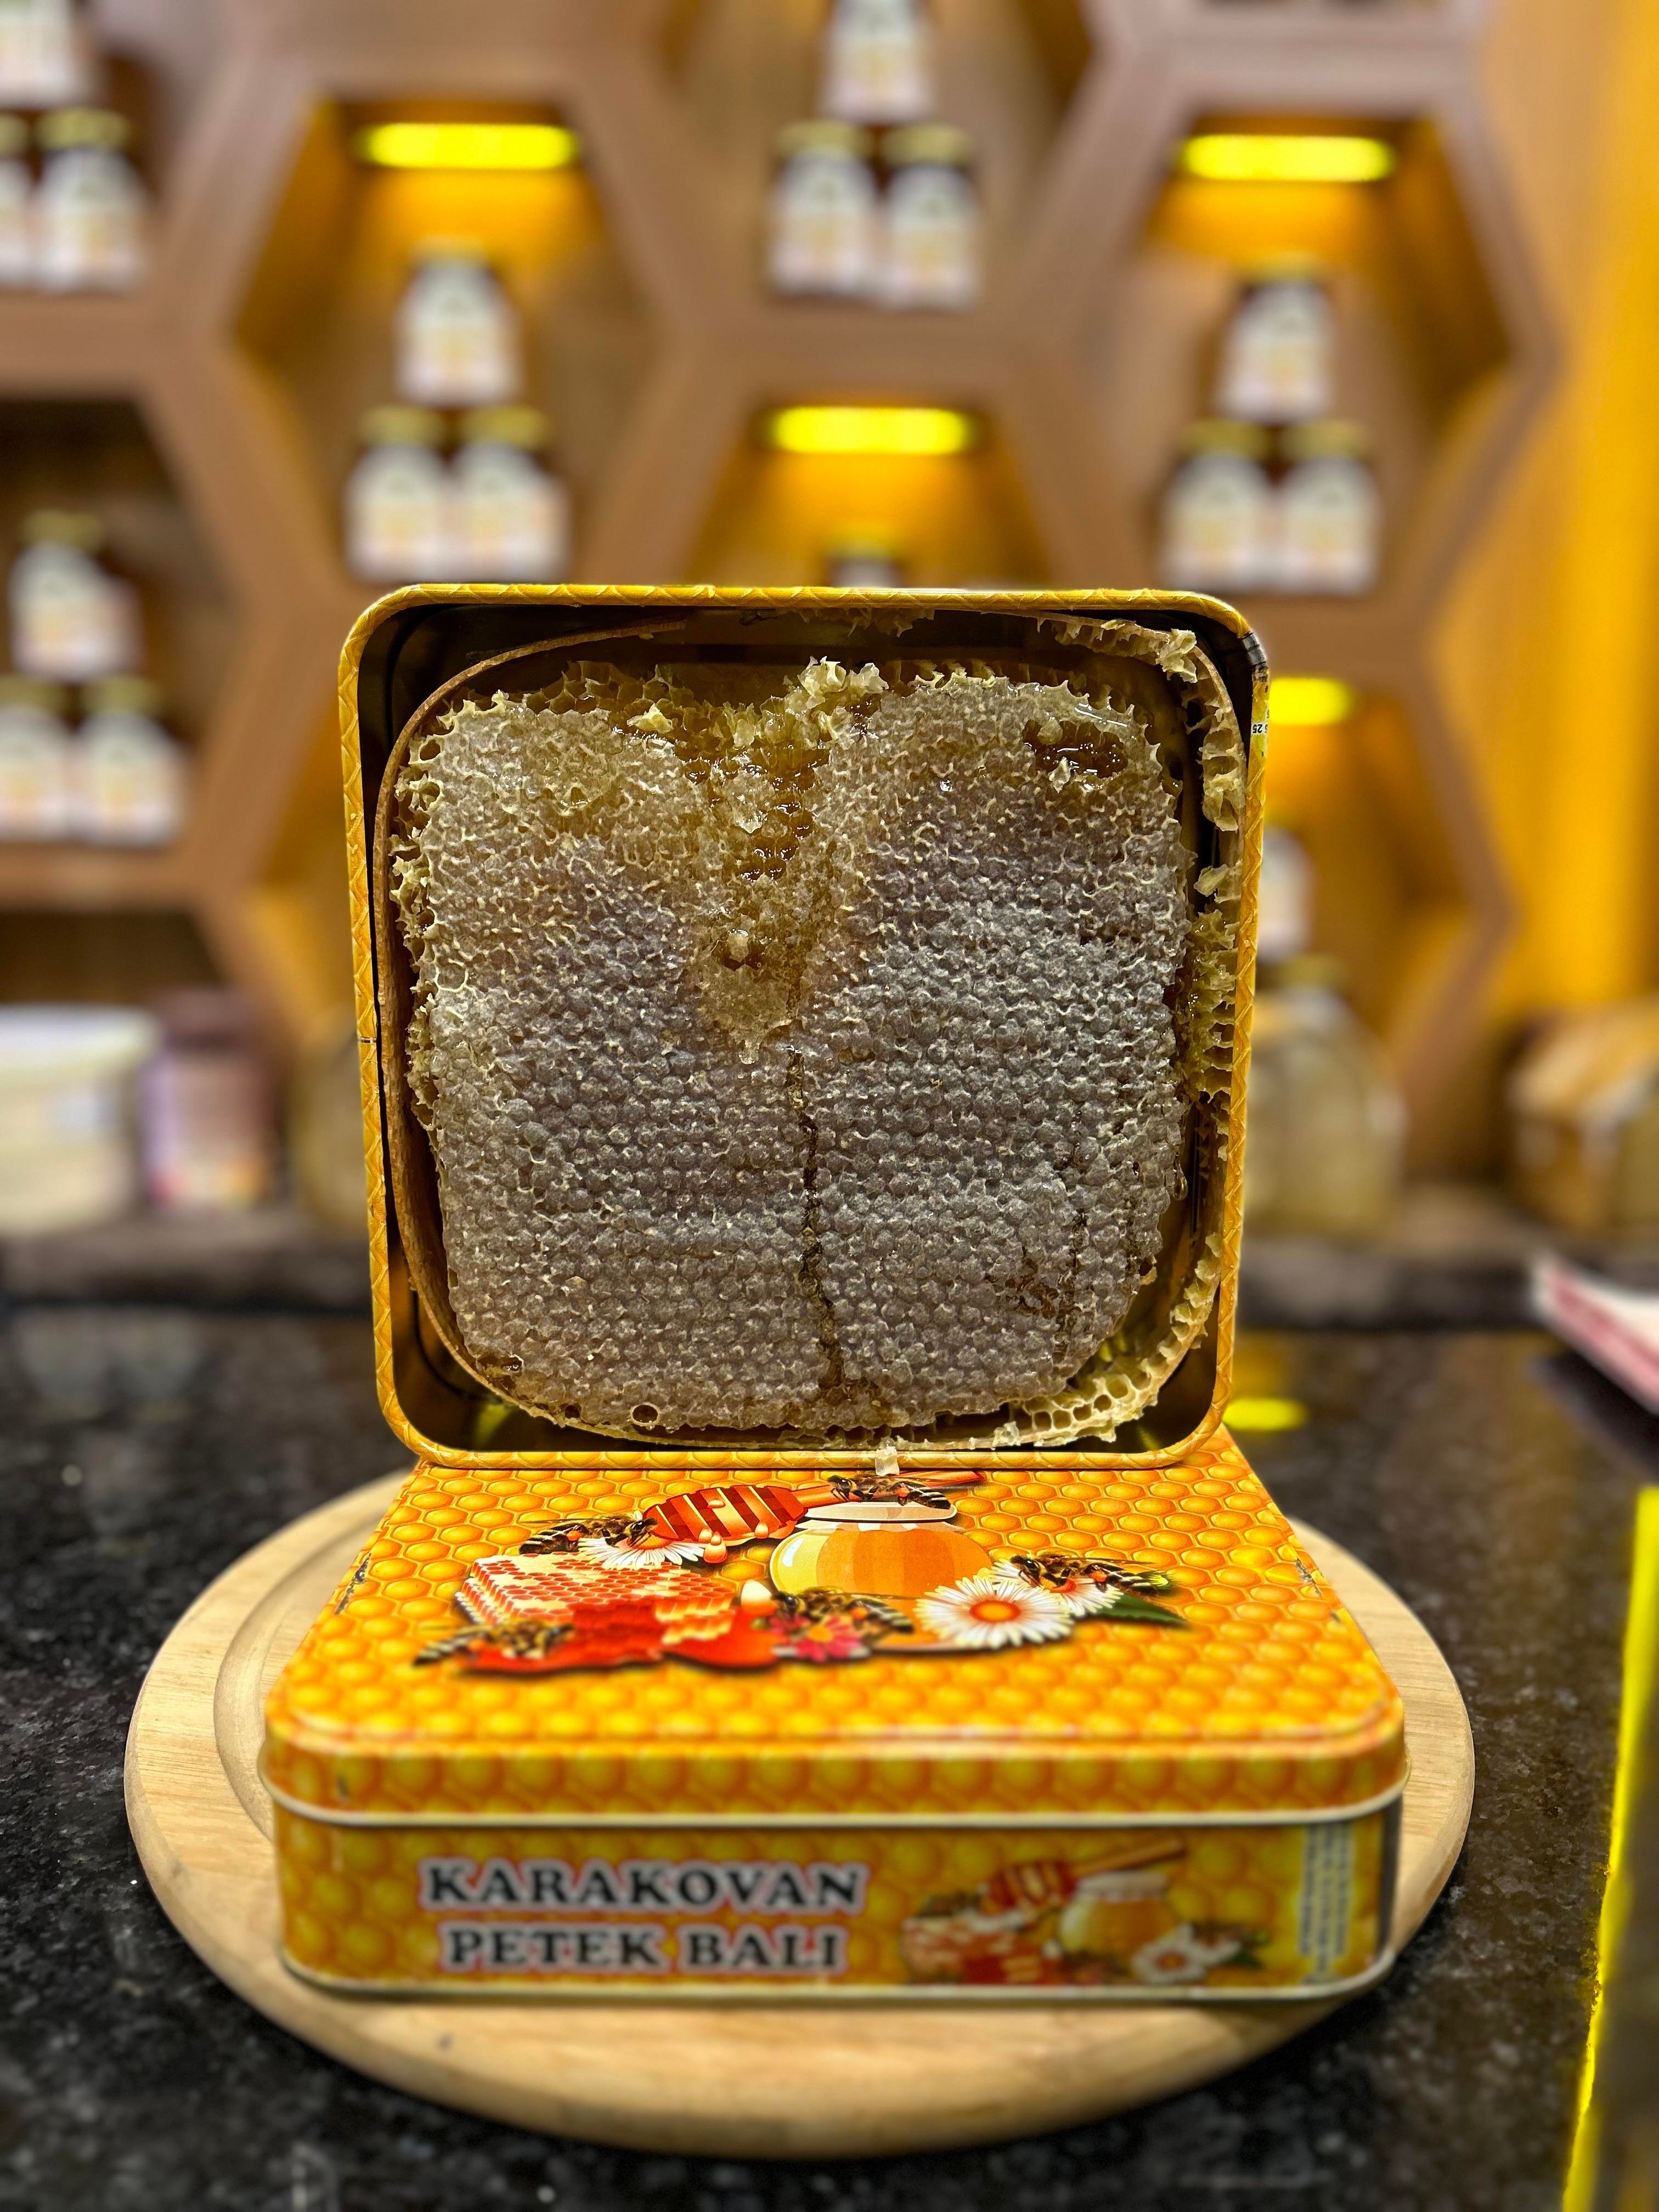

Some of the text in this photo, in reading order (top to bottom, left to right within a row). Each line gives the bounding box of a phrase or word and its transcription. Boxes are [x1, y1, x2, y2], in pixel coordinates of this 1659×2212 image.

[1252, 724, 1263, 733] 25
[427, 1864, 860, 1908] KARAKOVAN
[447, 1927, 840, 1969] PETEK BALI
